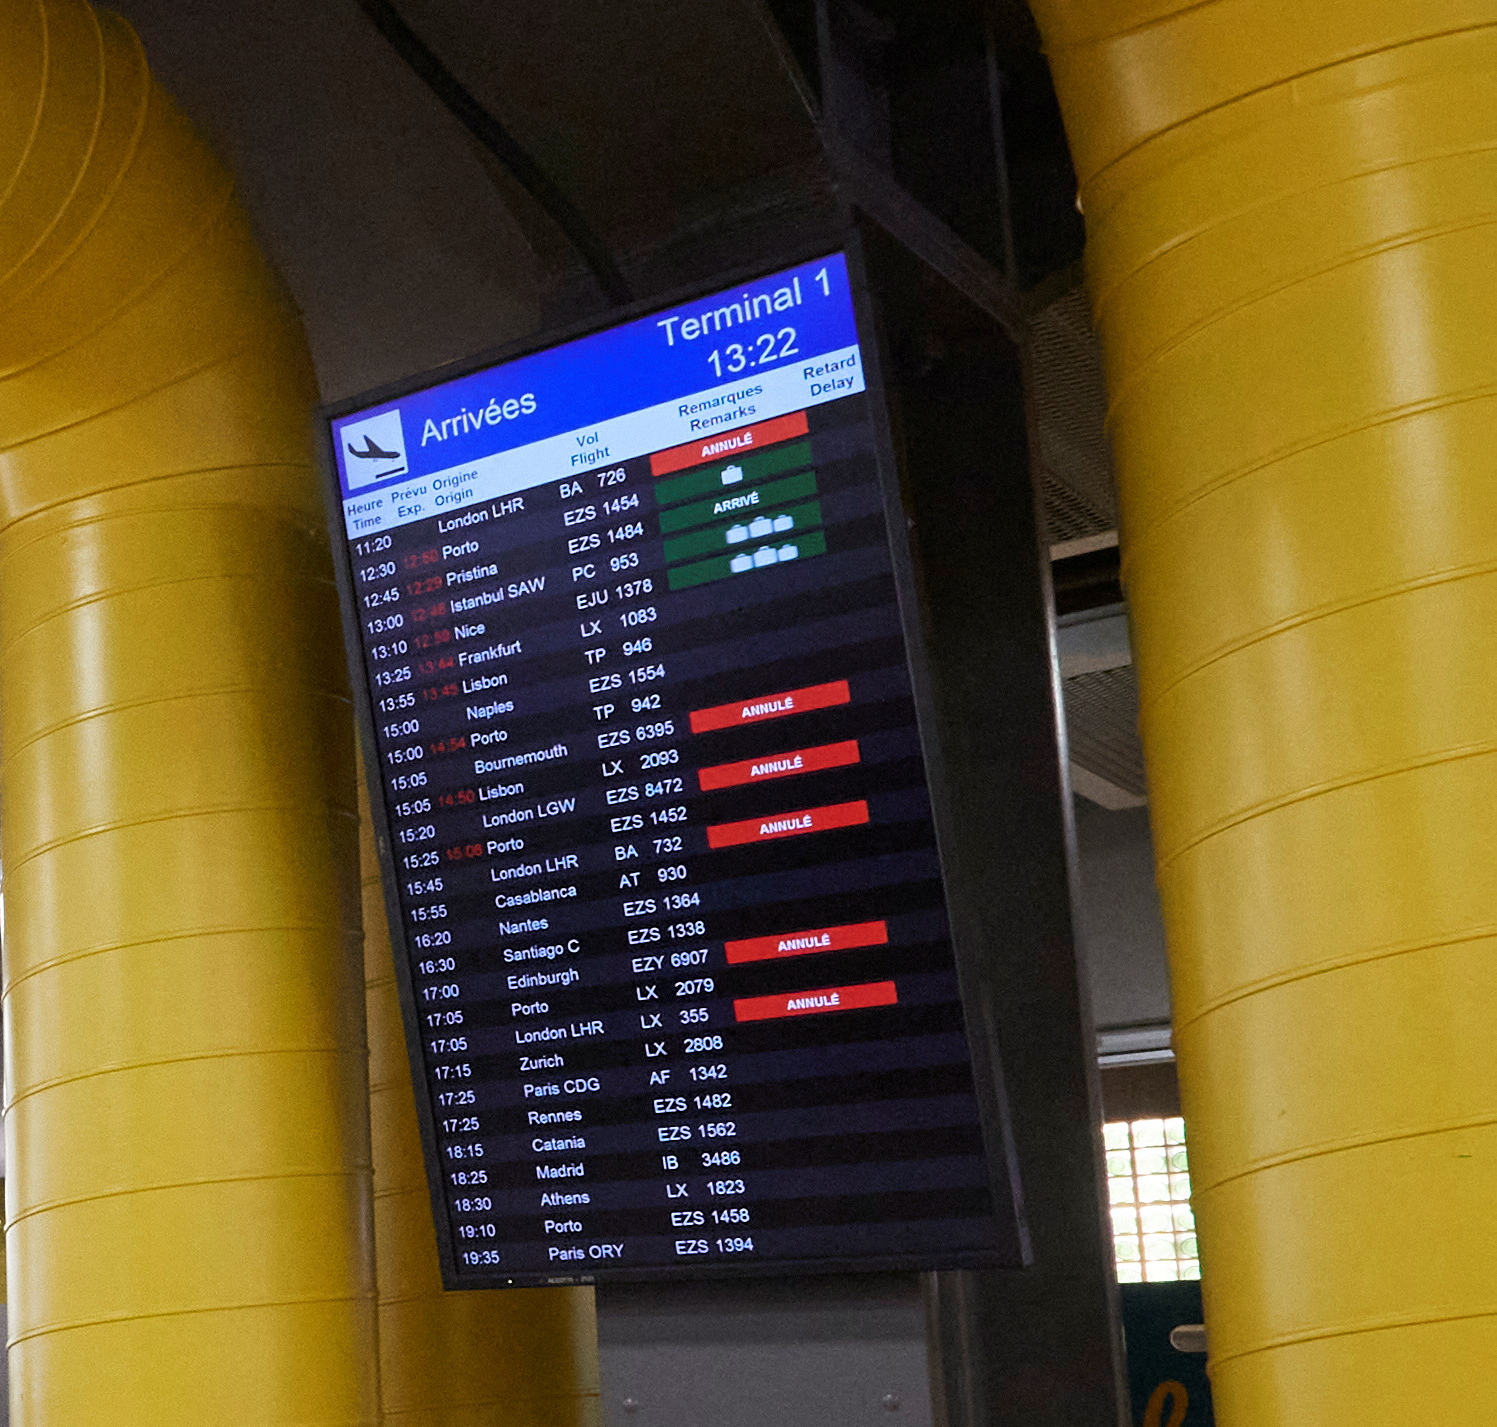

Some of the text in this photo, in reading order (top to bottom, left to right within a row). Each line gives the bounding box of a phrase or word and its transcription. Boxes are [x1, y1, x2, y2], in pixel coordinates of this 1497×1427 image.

[656, 267, 829, 346] Terminal 1
[707, 327, 799, 377] 13:22
[346, 352, 856, 517] Heure Prévu Origine Vol Remarques Retard
[421, 393, 536, 446] Arrivées
[351, 375, 854, 530] Time Exp. Origin Flight Remarks Delay
[356, 431, 753, 555] 11:20 London LHR BA 726 ANNULÉ
[360, 493, 639, 581] 12:30 Porto EZS 1454
[363, 490, 760, 607] 12:45 Pristina EZS 1484 ARRIVÉ
[367, 552, 639, 633] 13:00 Istanbul SAW PC 953
[375, 606, 657, 686] 13:25 Frankfurt LX 1083
[383, 663, 665, 737] 15:00 Naples EZS 1554
[391, 696, 794, 790] 15:05 Bournemouth EZS 6395 ANNULÉ
[399, 754, 803, 842] 15:20 London LGW EZS 8472 ANNULÉ
[403, 806, 687, 868] 15:25 Porto EZS 1452
[407, 814, 812, 895] 15:45 London LHR BA 732 ANNULÉ
[411, 864, 686, 921] 15:55 Casablanca AT 930
[415, 892, 700, 947] 16:20 Nantes EZS 1364
[419, 920, 705, 974] 16:30 Santiago C EZS 1338
[423, 933, 831, 1000] 17:00 Edinburgh EZY 6907 ANNULÉ
[426, 977, 714, 1026] 17:05 Porto LX 2079
[430, 992, 840, 1053] 17:05 London LHR LX 355 ANNULÉ
[435, 1035, 723, 1079] 17:15 Zurich LX 2808
[438, 1064, 727, 1105] 17:25 Paris CDG AF 1342
[442, 1092, 732, 1132] 17:25 Rennes EZS 1482
[446, 1121, 736, 1158] 18:15 Catania EZS 1562
[451, 1150, 740, 1185] 18:25 Madrid IB 3486
[455, 1179, 745, 1211] 18:30 Athens LX 1823
[459, 1207, 750, 1238] 19:10 Porto EZS 1458
[463, 1237, 753, 1264] 19:35 Paris ORY EZS 1394
